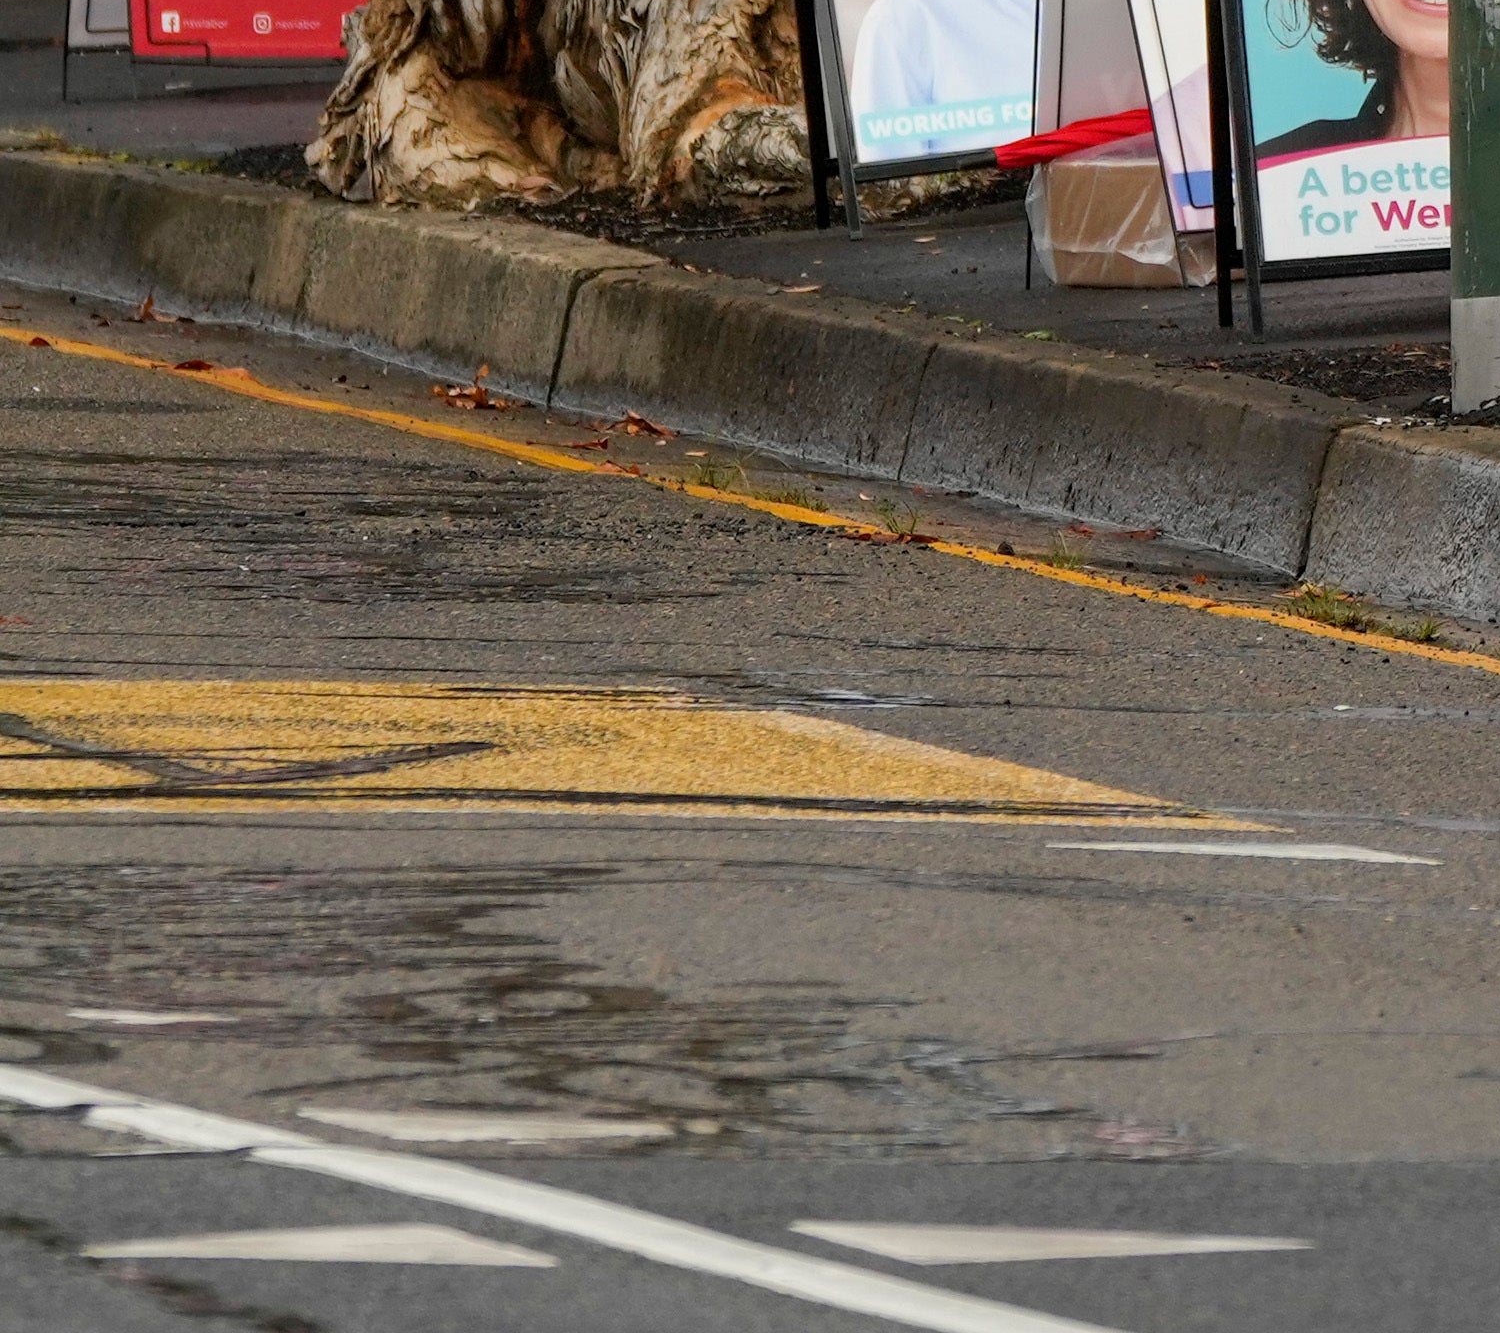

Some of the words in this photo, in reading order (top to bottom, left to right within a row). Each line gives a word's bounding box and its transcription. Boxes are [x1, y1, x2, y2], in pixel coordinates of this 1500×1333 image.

[867, 107, 994, 139] WORKING
[1298, 168, 1329, 198] A
[1300, 204, 1359, 236] for
